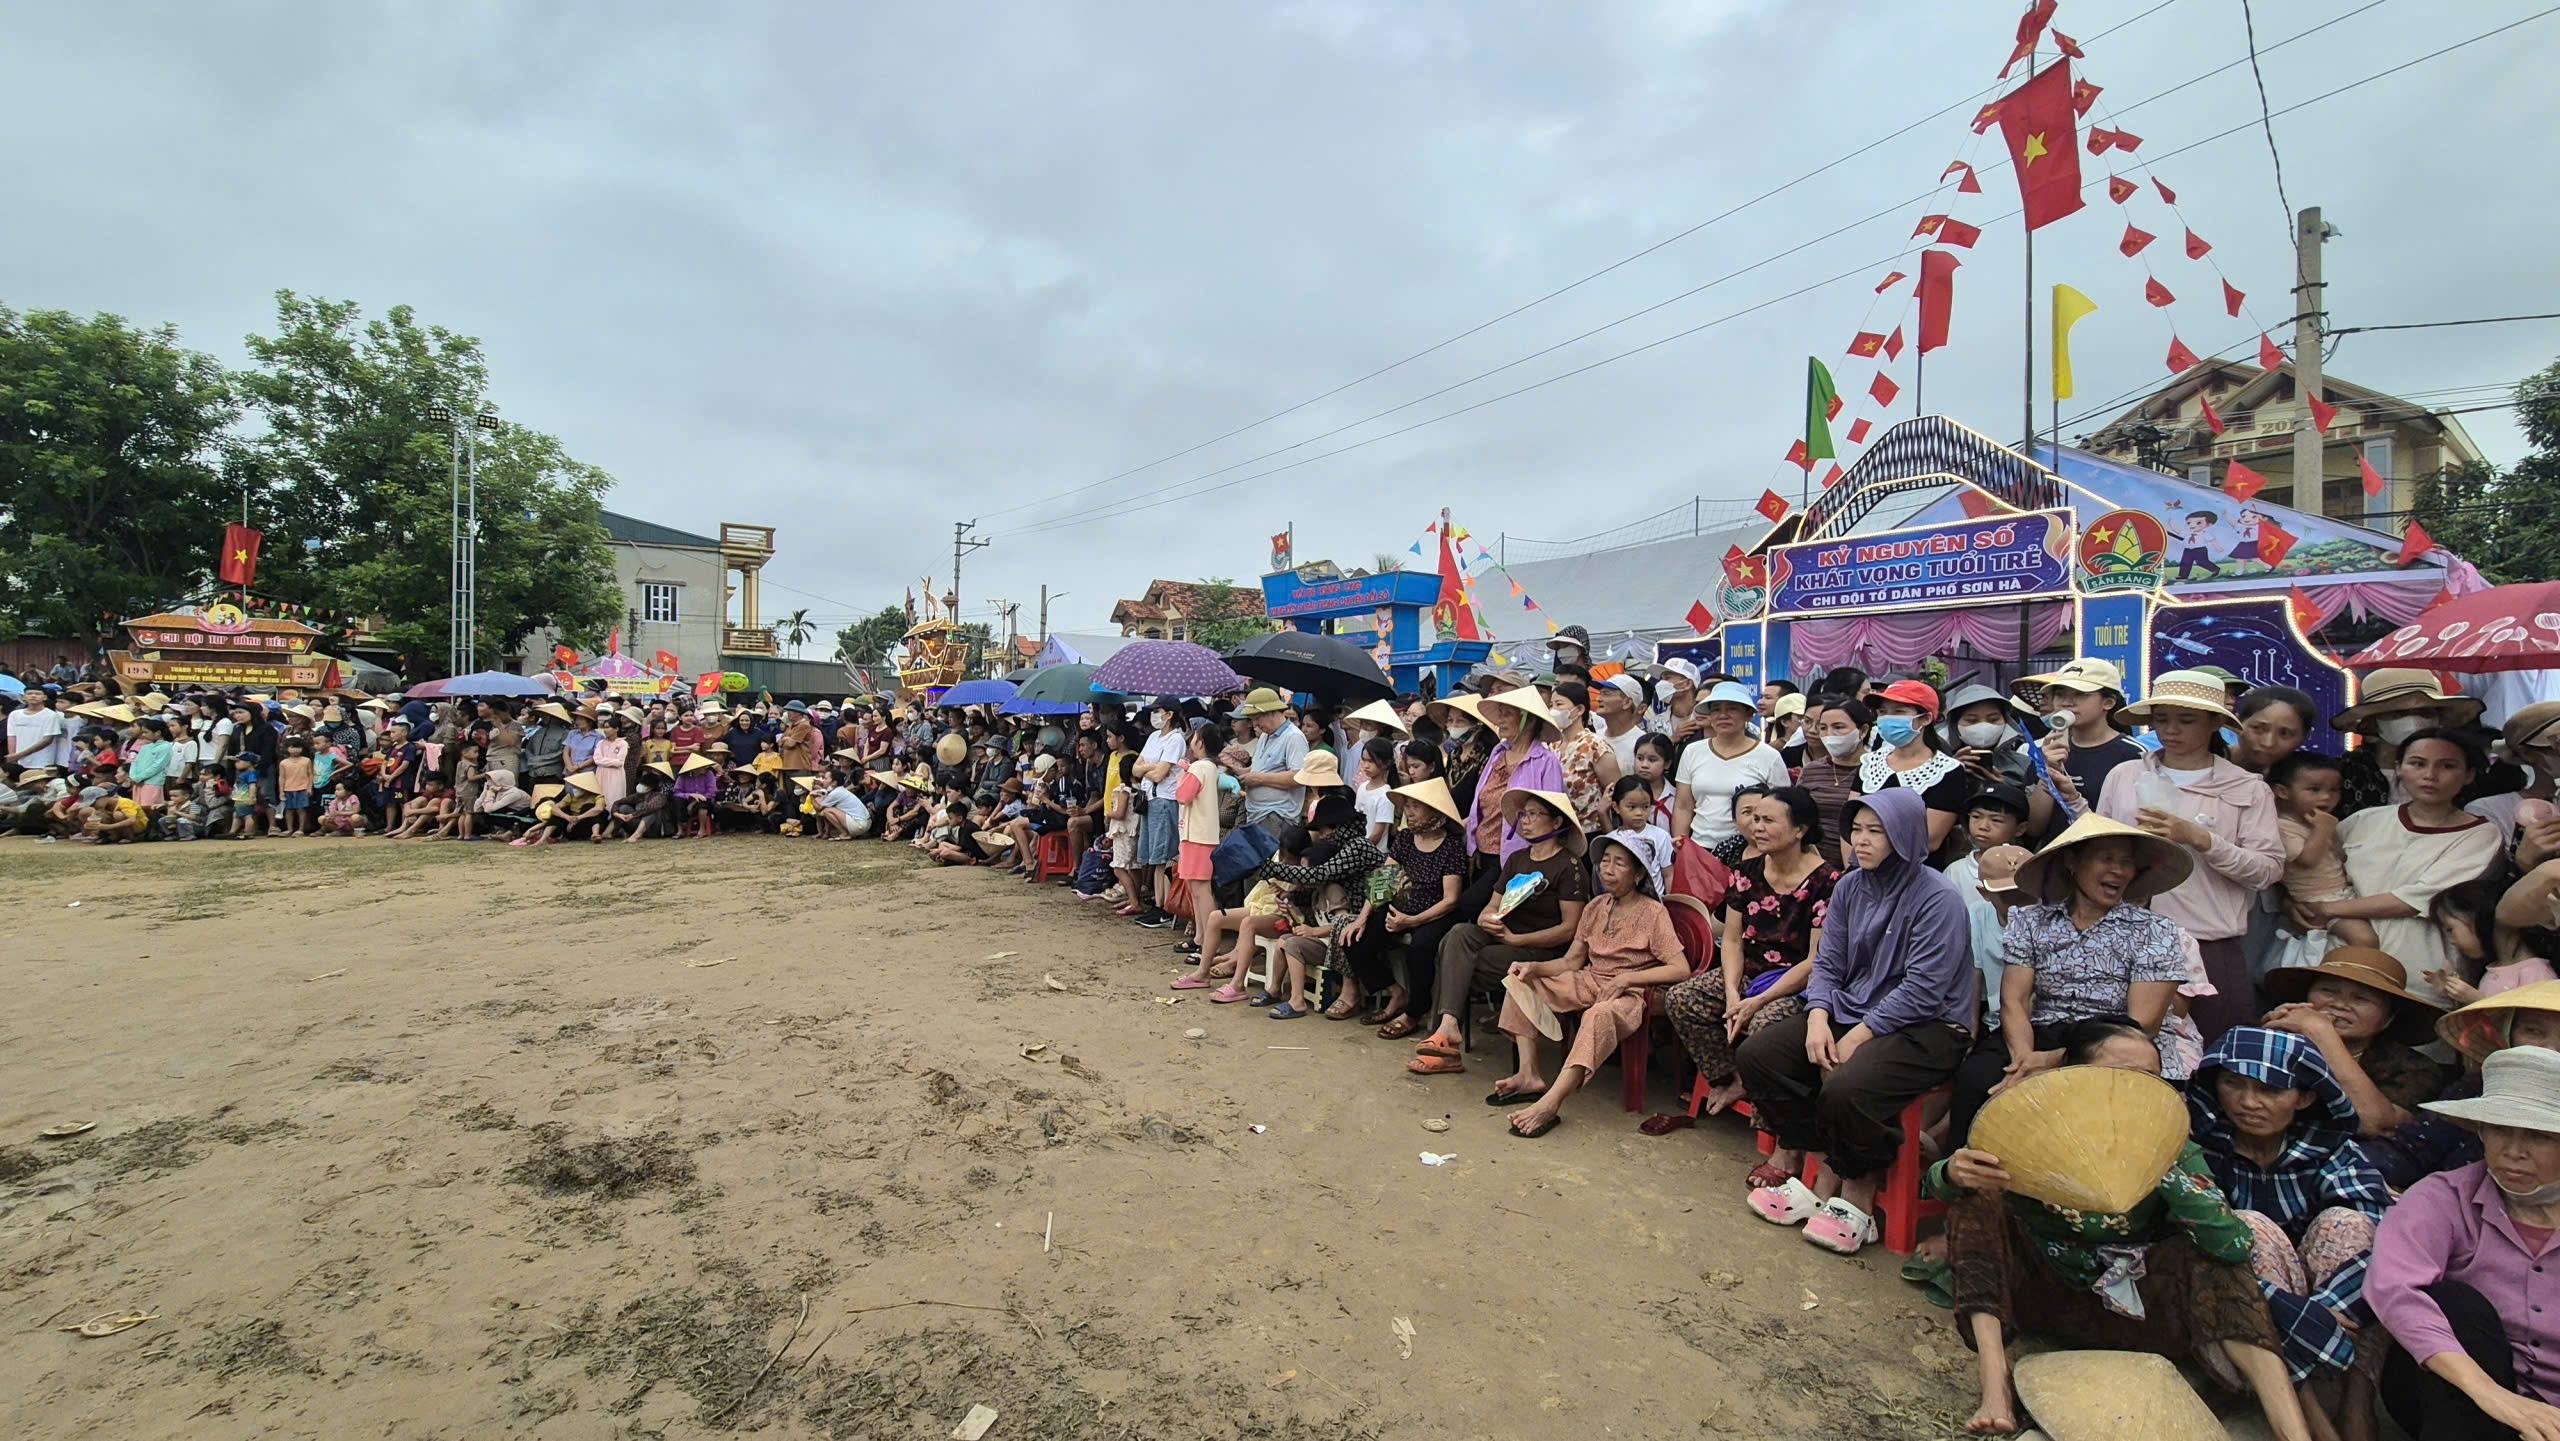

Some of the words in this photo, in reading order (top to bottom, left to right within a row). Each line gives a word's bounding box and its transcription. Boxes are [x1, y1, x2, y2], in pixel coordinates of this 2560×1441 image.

[1818, 544, 1852, 567] KỶ
[1856, 534, 1967, 563] NGUYÊN
[1973, 522, 2017, 549] SỐ
[1795, 567, 1853, 591] KHÁT
[1857, 562, 1921, 586] VỌNG
[1926, 550, 1985, 578] TUỔI
[1989, 544, 2042, 572] TRẺ
[1812, 596, 1836, 607] CHI
[1840, 590, 1865, 604] ĐỘI
[1891, 586, 1921, 600] DÂN
[1926, 581, 1958, 597] PHỐ
[1962, 580, 1994, 594] SƠN
[1998, 577, 2022, 591] HÀ
[2094, 617, 2112, 647] TUỔI
[2113, 615, 2129, 646] TRẺ
